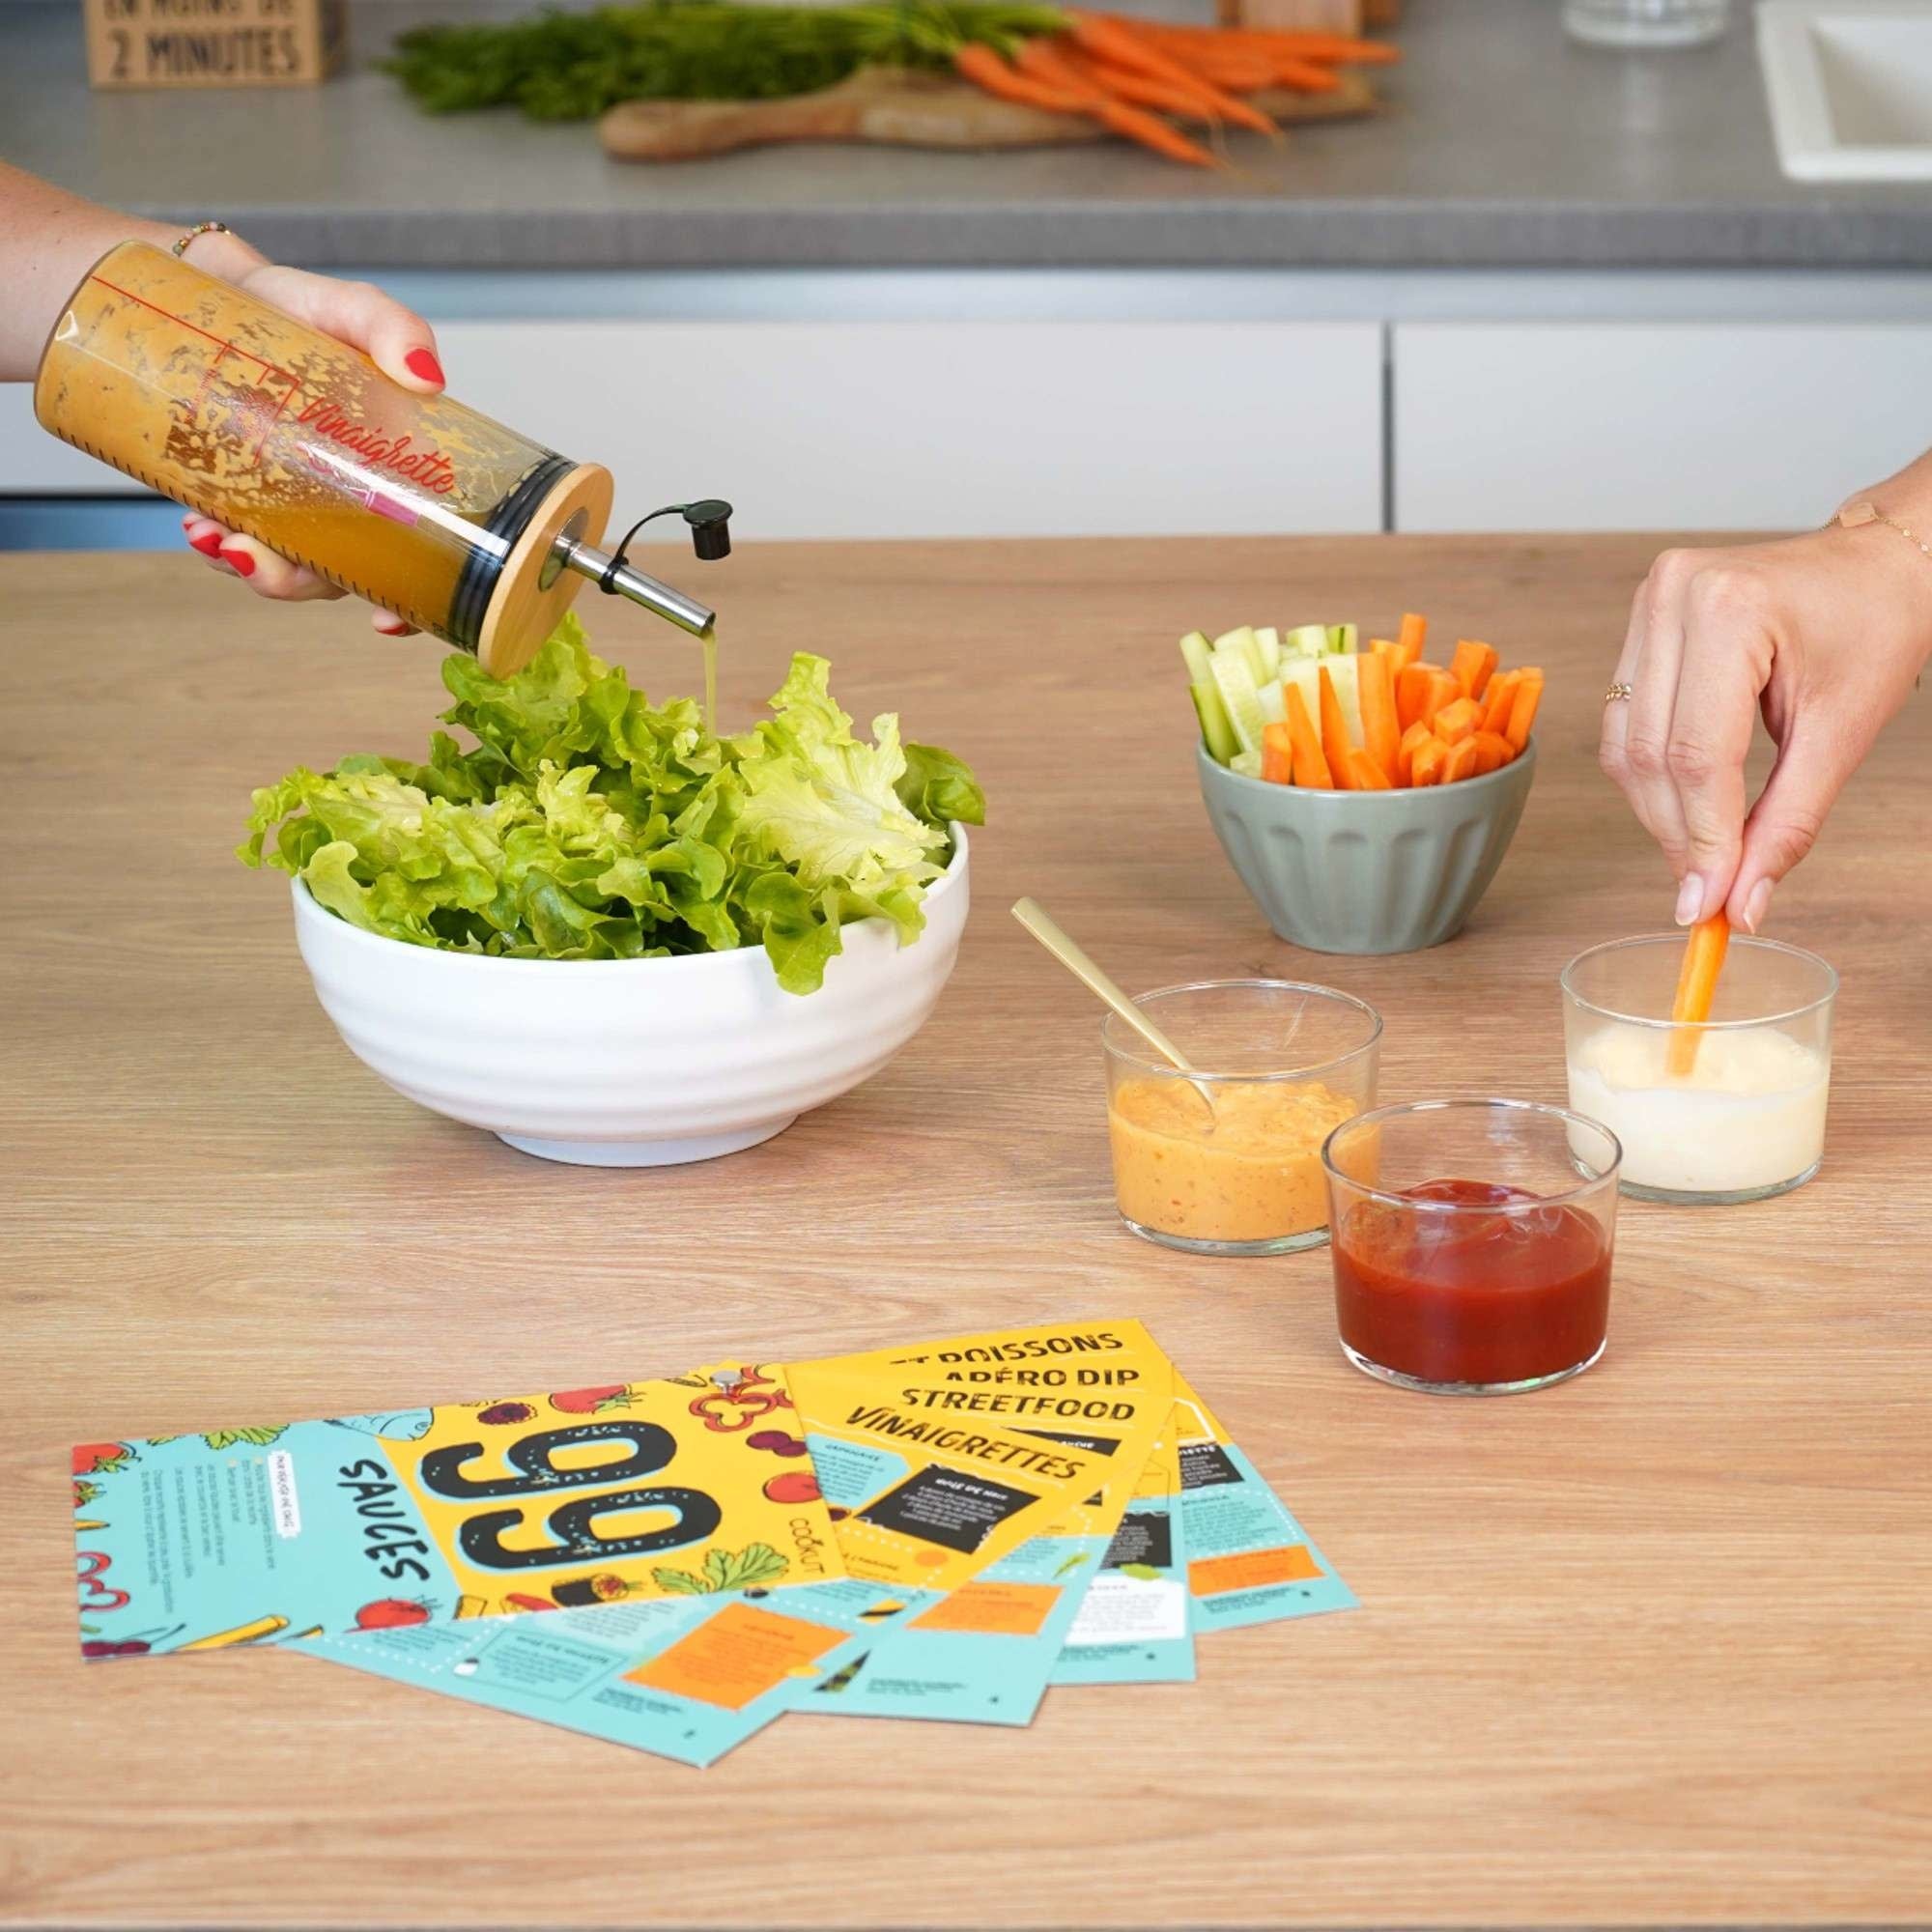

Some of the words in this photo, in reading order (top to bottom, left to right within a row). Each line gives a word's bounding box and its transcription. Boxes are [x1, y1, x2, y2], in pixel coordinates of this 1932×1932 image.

[107, 27, 131, 77] 2
[146, 27, 301, 76] MINUTES
[297, 396, 456, 495] Vinaigrette
[901, 1388, 1136, 1420] STREETFOOD
[1077, 1369, 1140, 1386] DIP
[845, 1406, 1086, 1479] VINAIGRETTES
[337, 1459, 431, 1581] SAUCES
